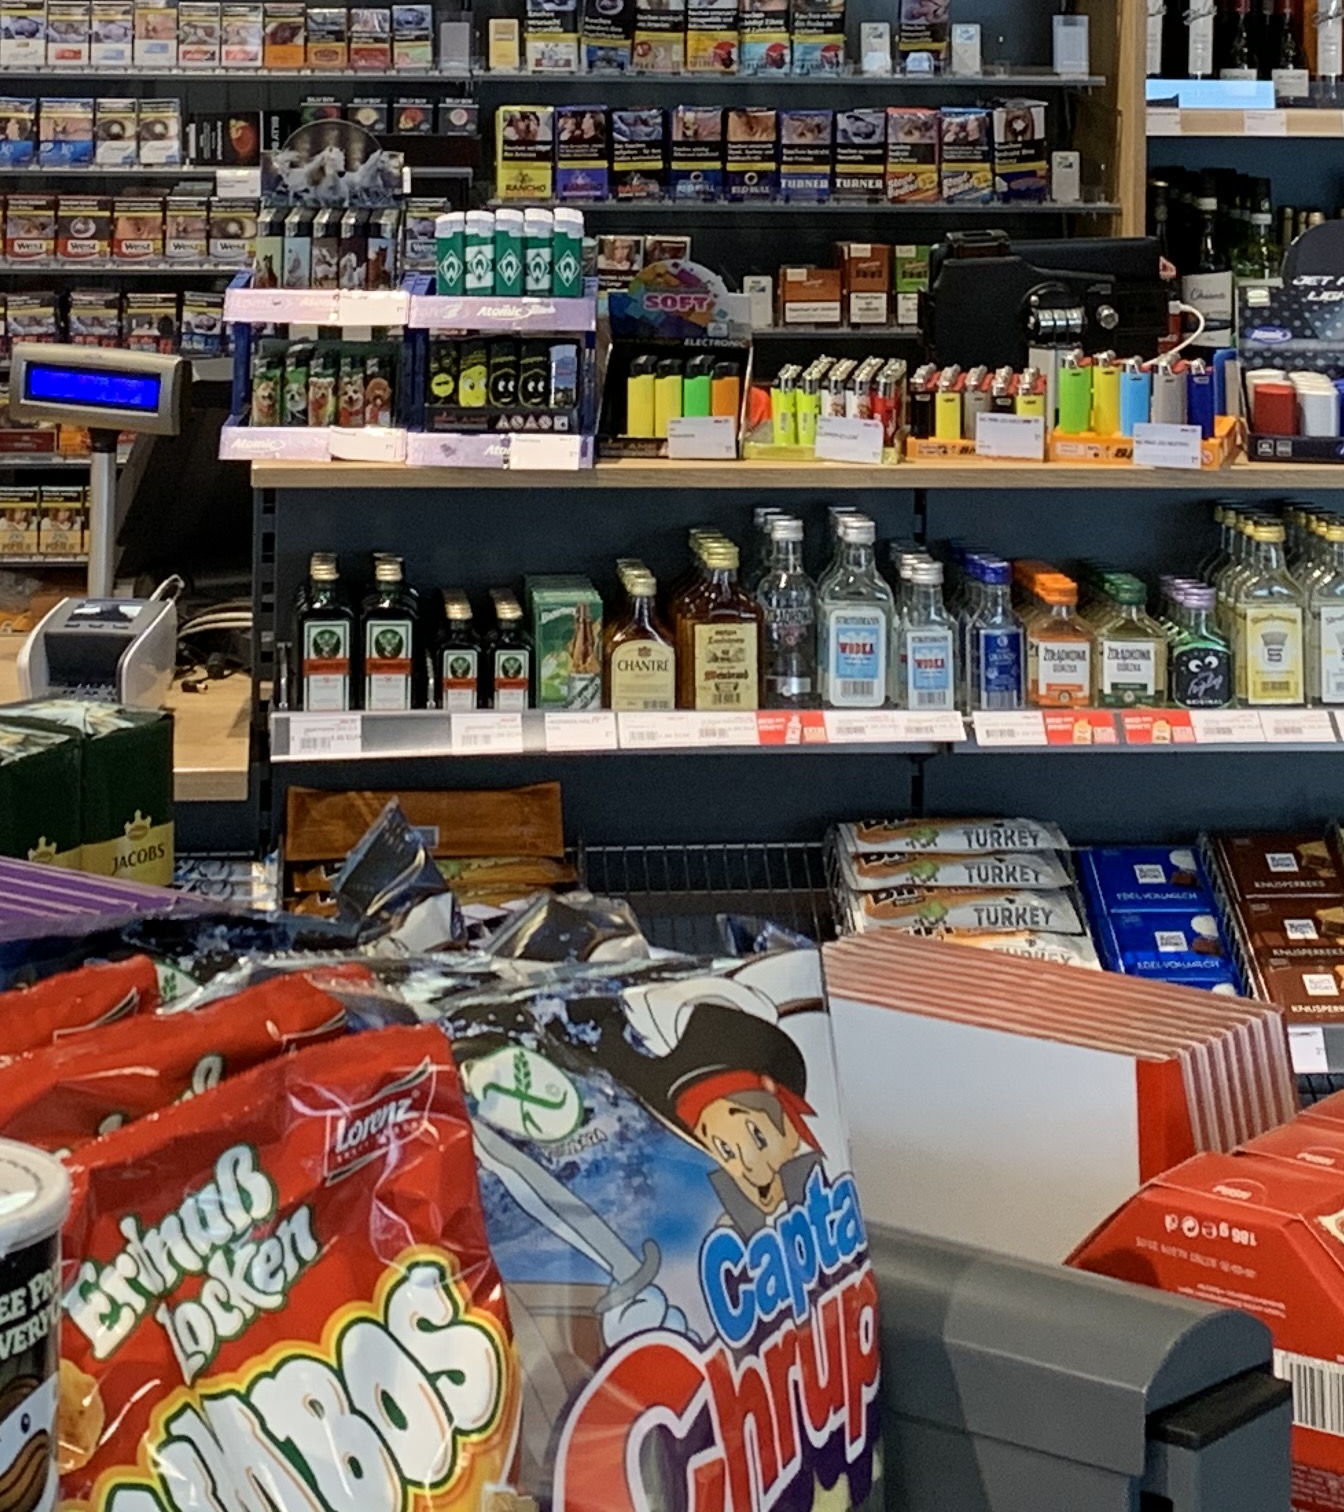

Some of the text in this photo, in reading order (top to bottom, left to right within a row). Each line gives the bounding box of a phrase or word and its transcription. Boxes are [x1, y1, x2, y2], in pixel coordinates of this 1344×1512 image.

[835, 178, 883, 189] TURNER
[1291, 275, 1331, 287] JET
[642, 292, 713, 313] SOFT
[477, 304, 525, 318] Atomic
[231, 438, 282, 451] Atomic
[838, 642, 875, 656] WODKA
[617, 657, 670, 672] CHANTRÉ
[914, 658, 945, 669] WODKA
[963, 828, 1041, 849] TURKEY
[112, 845, 166, 873] JACOBS
[964, 864, 1042, 883] TURKEY
[1254, 880, 1325, 889] KNUSPERKEKS
[974, 905, 1054, 927] TURKEY
[333, 1095, 417, 1153] Lorenz
[61, 1143, 279, 1361] Erdnuß
